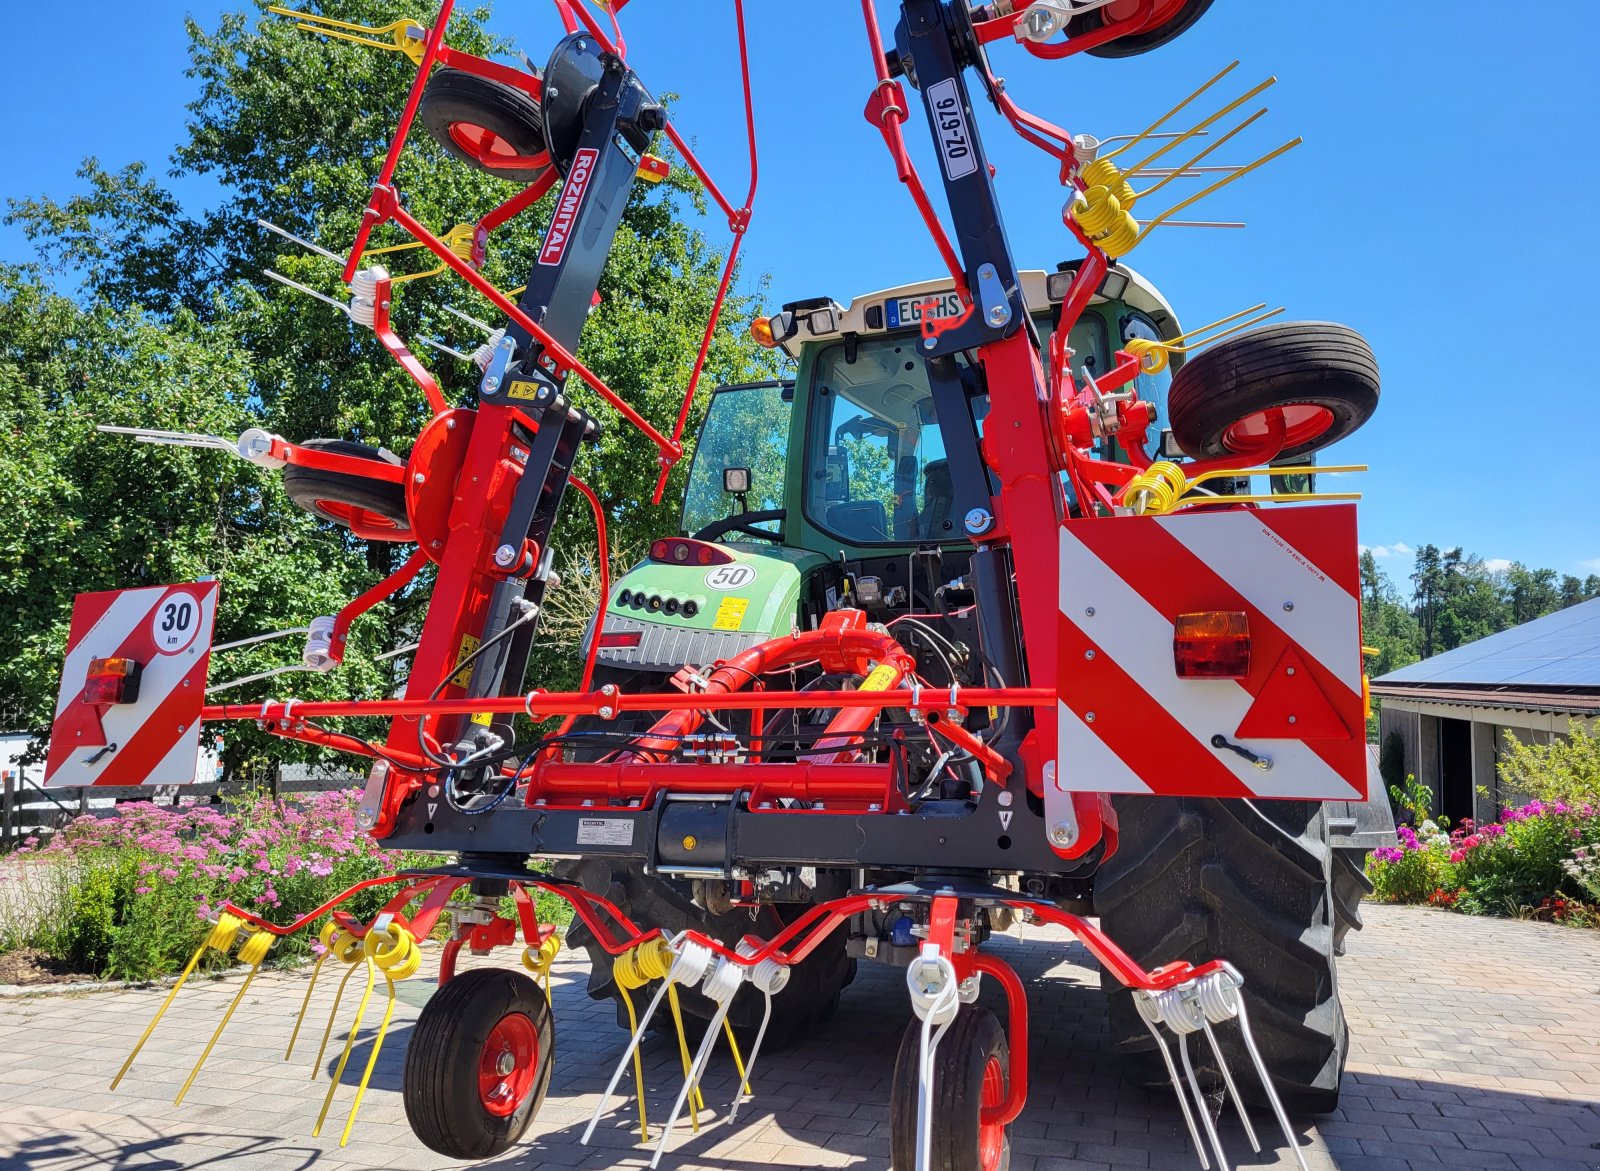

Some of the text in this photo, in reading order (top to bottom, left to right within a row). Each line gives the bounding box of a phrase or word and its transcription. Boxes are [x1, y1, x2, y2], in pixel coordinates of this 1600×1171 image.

[545, 155, 593, 258] ROZMITAL
[899, 294, 960, 323] EG HS
[1261, 528, 1271, 537] DIN
[712, 567, 749, 586] 50
[162, 602, 192, 632] 30
[166, 635, 178, 645] km
